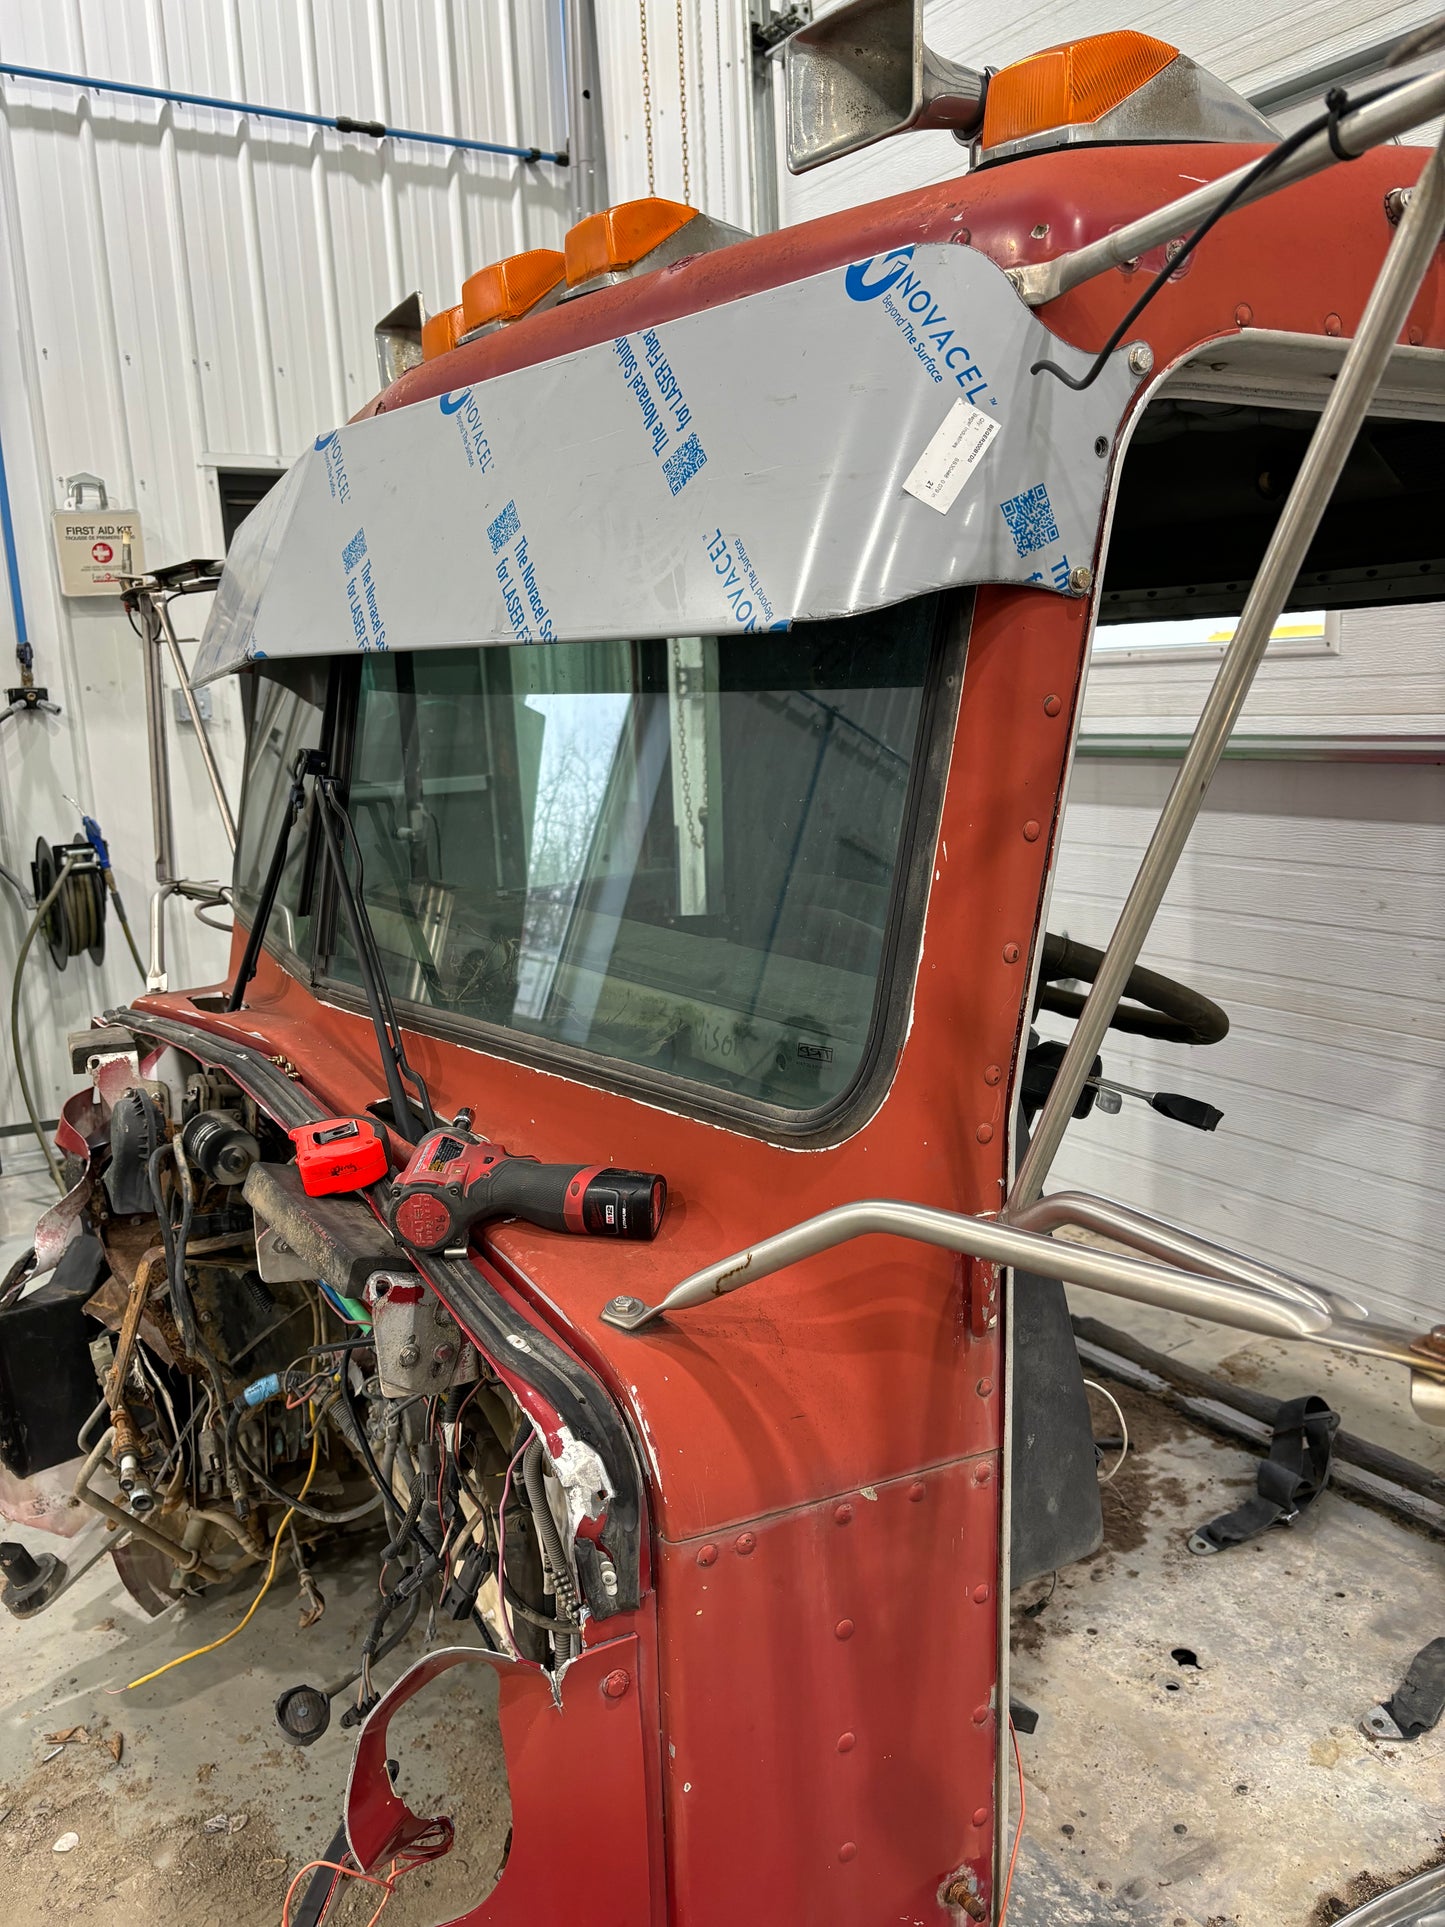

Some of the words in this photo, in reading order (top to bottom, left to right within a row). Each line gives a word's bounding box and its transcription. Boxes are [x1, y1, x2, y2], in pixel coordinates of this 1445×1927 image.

[882, 294, 905, 327] Beyond
[902, 322, 917, 344] The
[913, 341, 943, 384] Surface
[896, 270, 989, 405] NOVACEL
[627, 372, 659, 430] Novacel
[654, 359, 682, 411] LASER
[463, 396, 492, 474] NOVACEL
[675, 403, 692, 432] for
[652, 422, 669, 457] The
[330, 435, 349, 504] NOVACEL
[66, 526, 95, 535] FIRST
[98, 526, 115, 535] AID
[496, 557, 509, 583] for
[514, 535, 529, 568] The
[735, 538, 752, 573] Surface
[347, 577, 357, 599] for
[360, 559, 372, 587] The
[707, 528, 762, 634] NOVACEL
[748, 569, 759, 592] The
[1051, 555, 1071, 594] Th
[364, 581, 385, 635] Novacel
[502, 578, 524, 631] LASER
[521, 562, 550, 624] Novacel
[754, 587, 774, 622] Beyond
[350, 595, 365, 640] LASER
[606, 1206, 614, 1223] M12
